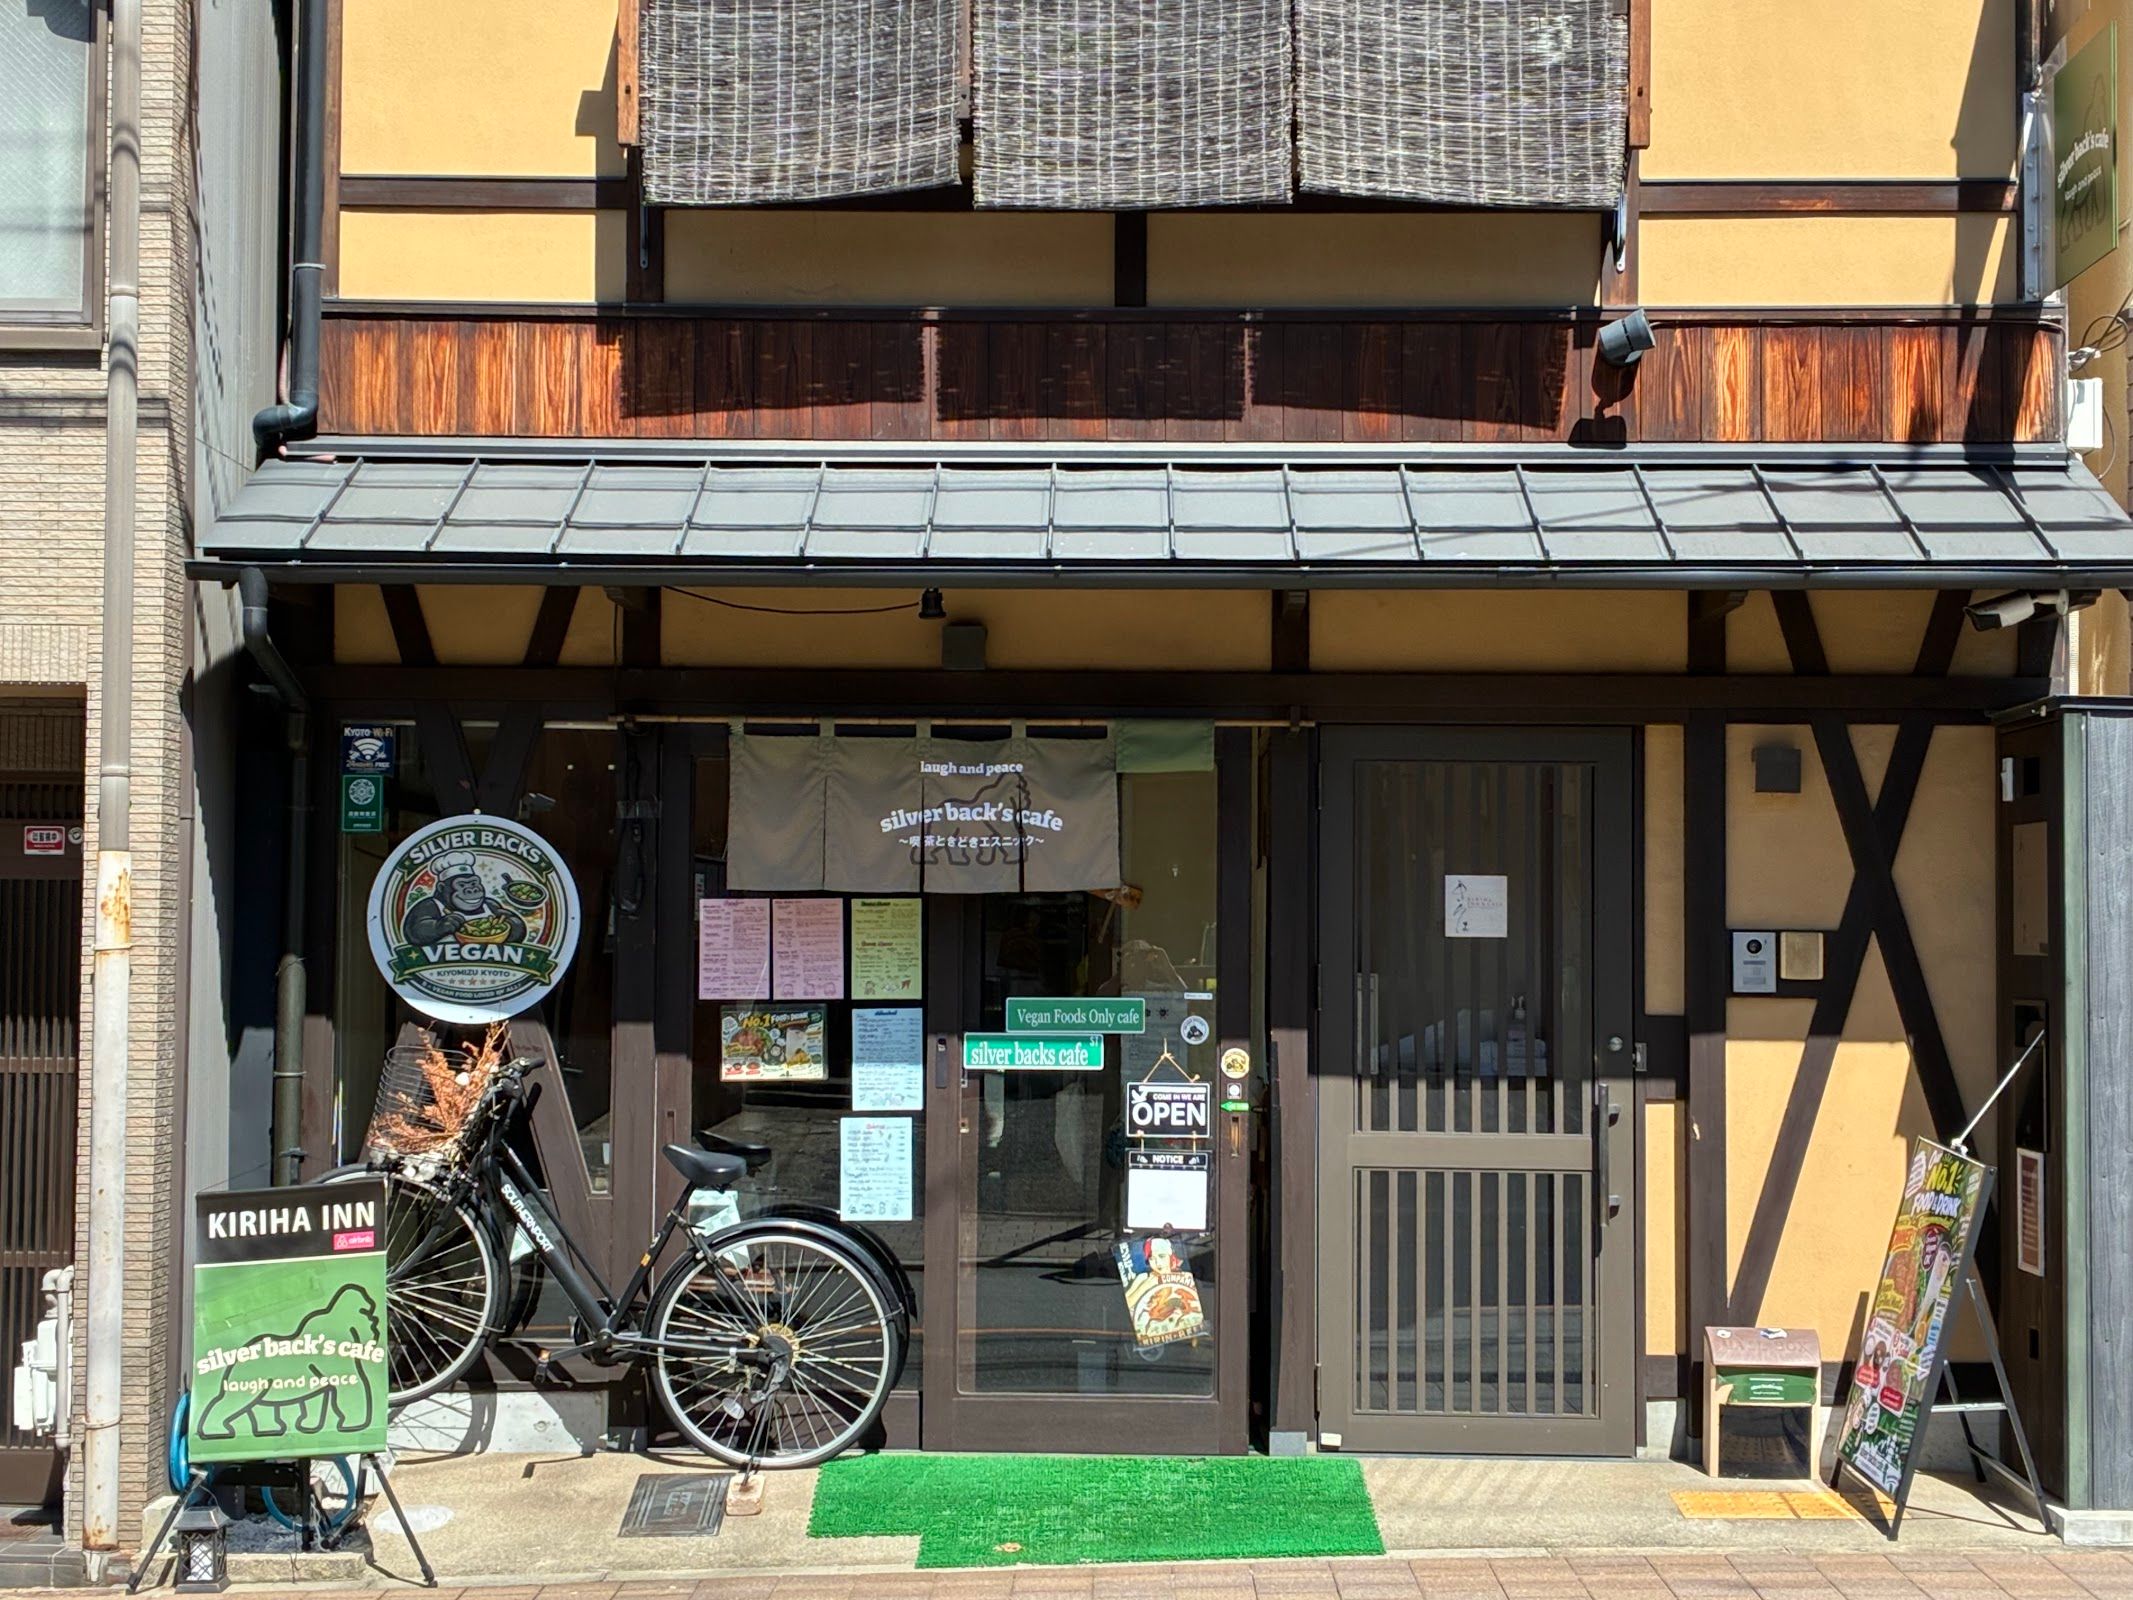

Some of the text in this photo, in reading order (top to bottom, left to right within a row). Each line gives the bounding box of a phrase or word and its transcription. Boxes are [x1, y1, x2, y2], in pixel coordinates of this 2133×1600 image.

[2058, 127, 2109, 189] silver back's cafe
[920, 761, 1024, 777] laugh and peace
[880, 802, 1063, 833] silver back's cafe
[410, 831, 542, 865] SILVER BACKS
[422, 943, 523, 964] VEGAN
[437, 969, 510, 978] KIYOMIZU KYOTO
[1017, 1008, 1140, 1028] Vegan Foods Only cafe
[971, 1041, 1089, 1066] silver backs cafe
[1152, 1093, 1172, 1101] COME
[1173, 1093, 1181, 1101] IN
[1181, 1093, 1193, 1101] WE
[1132, 1102, 1206, 1126] OPEN
[1152, 1154, 1184, 1164] NOTICE
[208, 1201, 375, 1239] KIRIHA INN
[196, 1333, 385, 1375] silver back's cafe
[223, 1374, 359, 1394] laugh and peace
